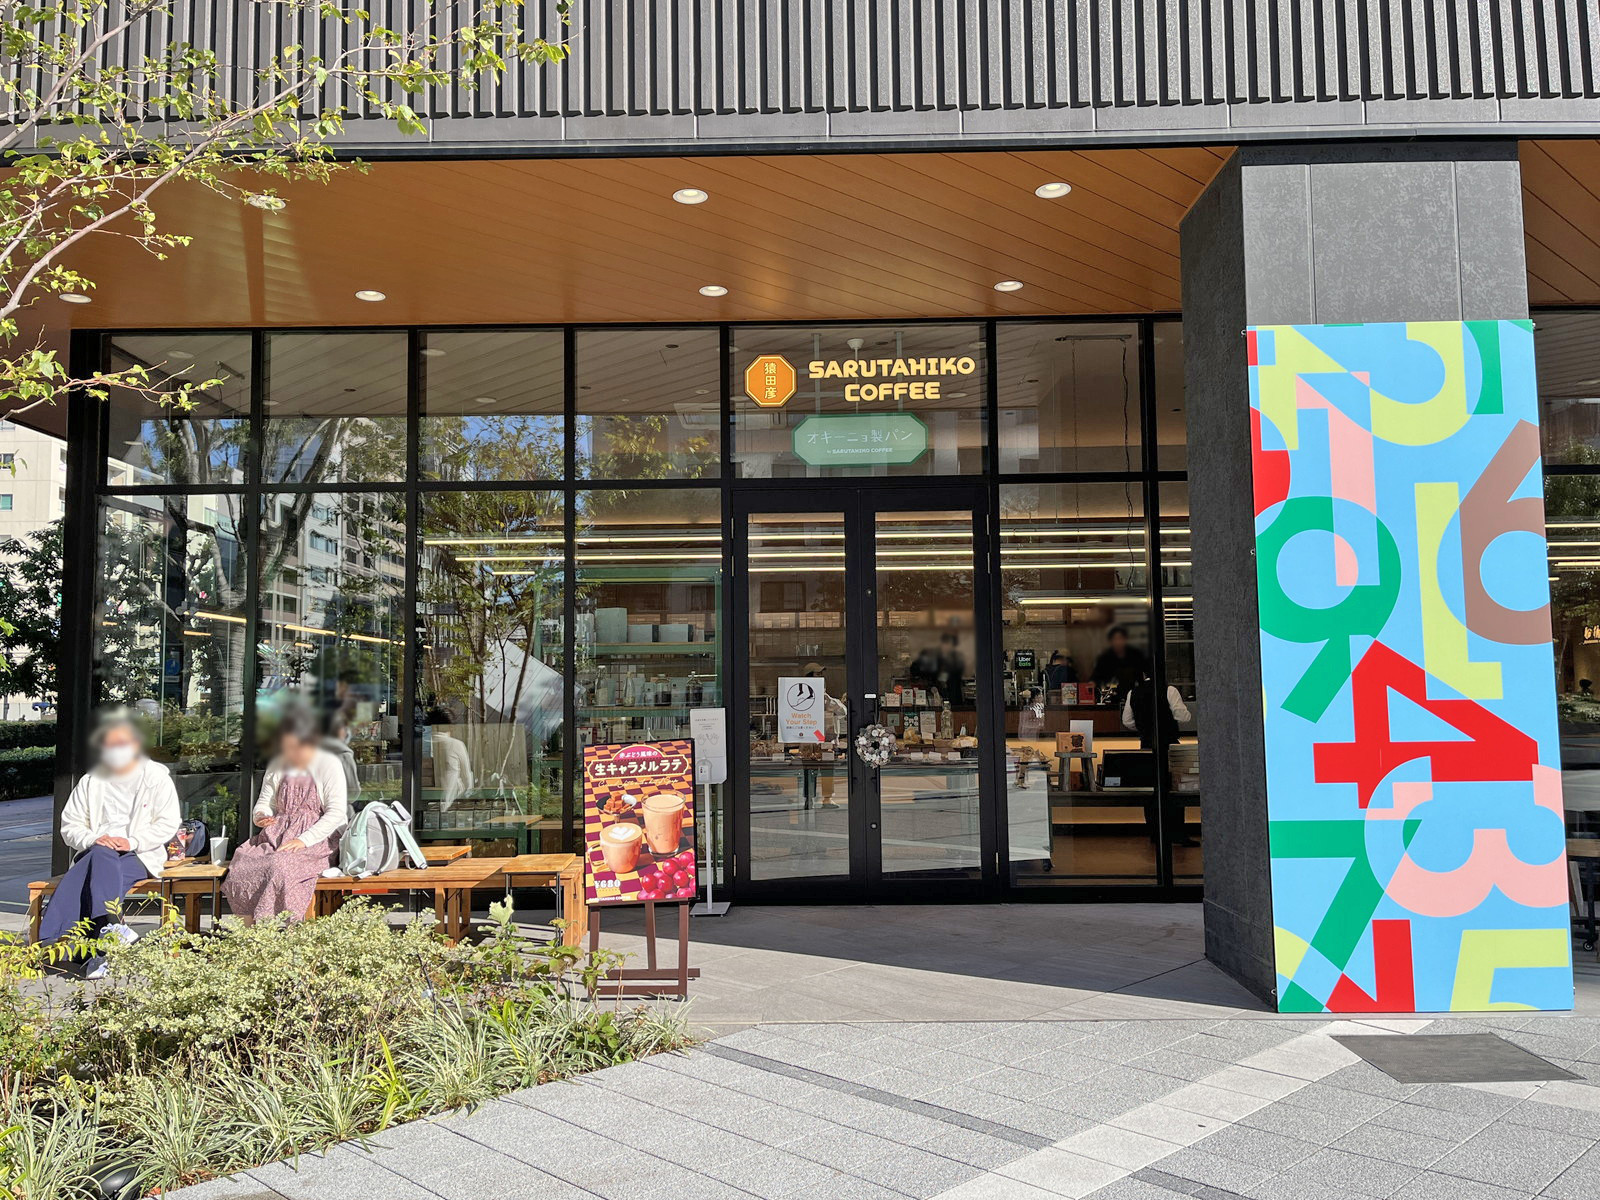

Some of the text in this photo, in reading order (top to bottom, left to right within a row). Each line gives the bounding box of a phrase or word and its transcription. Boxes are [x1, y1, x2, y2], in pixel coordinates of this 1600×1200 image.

[808, 356, 976, 379] SARUTAHIKO
[764, 362, 777, 399] 猿田彦
[844, 381, 941, 402] COFFEE
[807, 428, 913, 445] オキーニョ製パン
[1312, 639, 1539, 809] 4
[594, 758, 682, 777] 生キャラメルラテ
